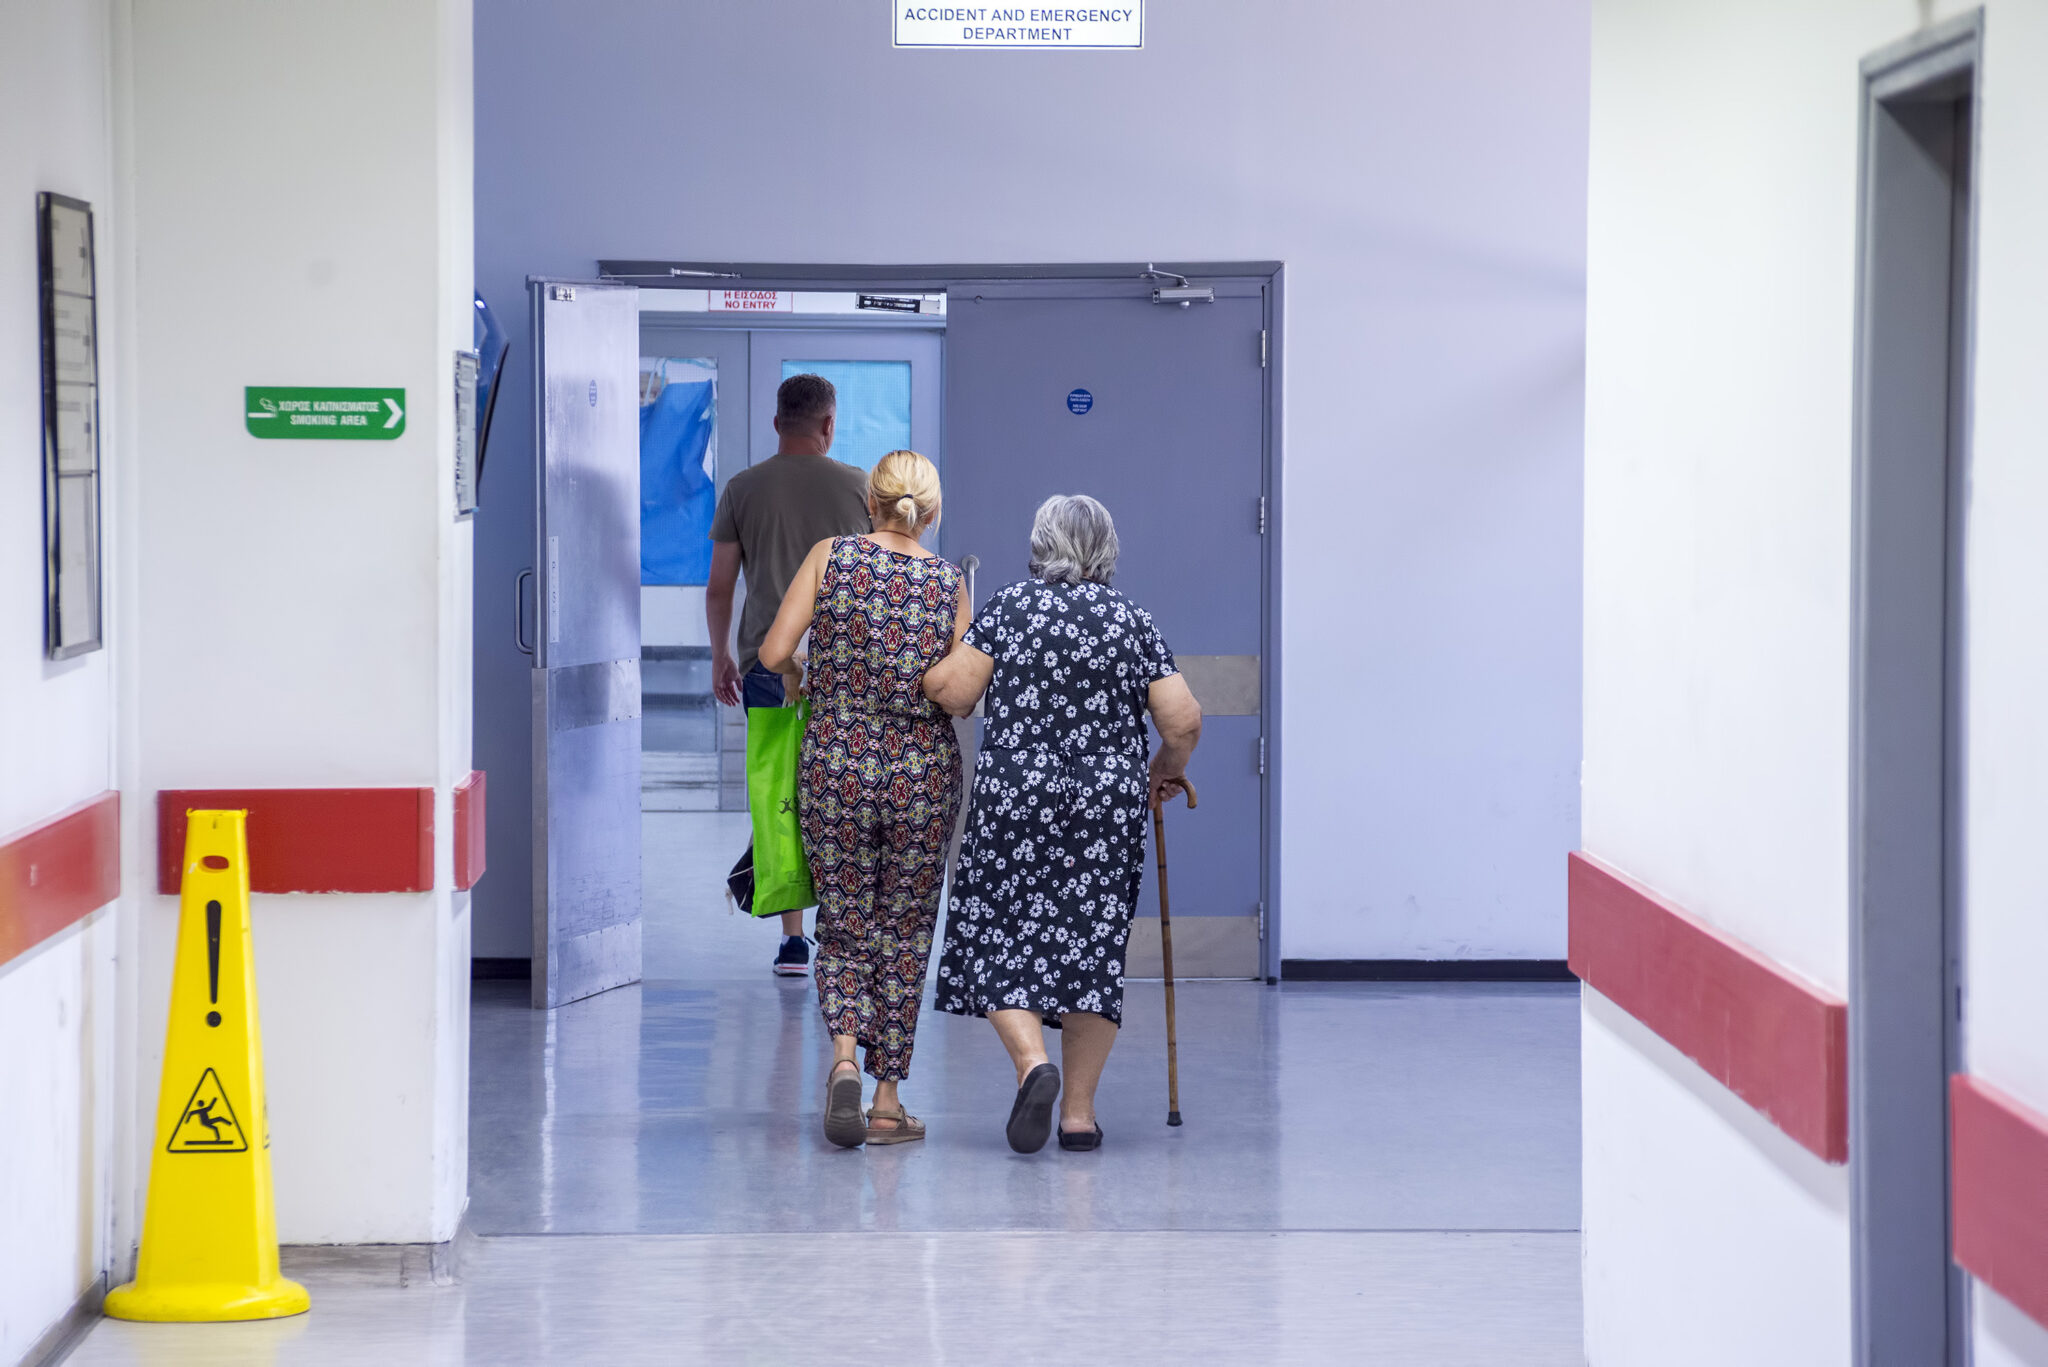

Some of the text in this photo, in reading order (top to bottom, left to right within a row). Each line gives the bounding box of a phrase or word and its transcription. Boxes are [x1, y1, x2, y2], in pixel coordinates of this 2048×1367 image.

[904, 8, 1132, 22] ACCIDENT AND EMERGENCY
[963, 27, 1072, 40] DEPARTMENT
[734, 291, 777, 300] ΕΙΣΟΔΟΣ
[725, 301, 776, 309] NO ENTRY
[290, 415, 368, 426] SMOKING AREA
